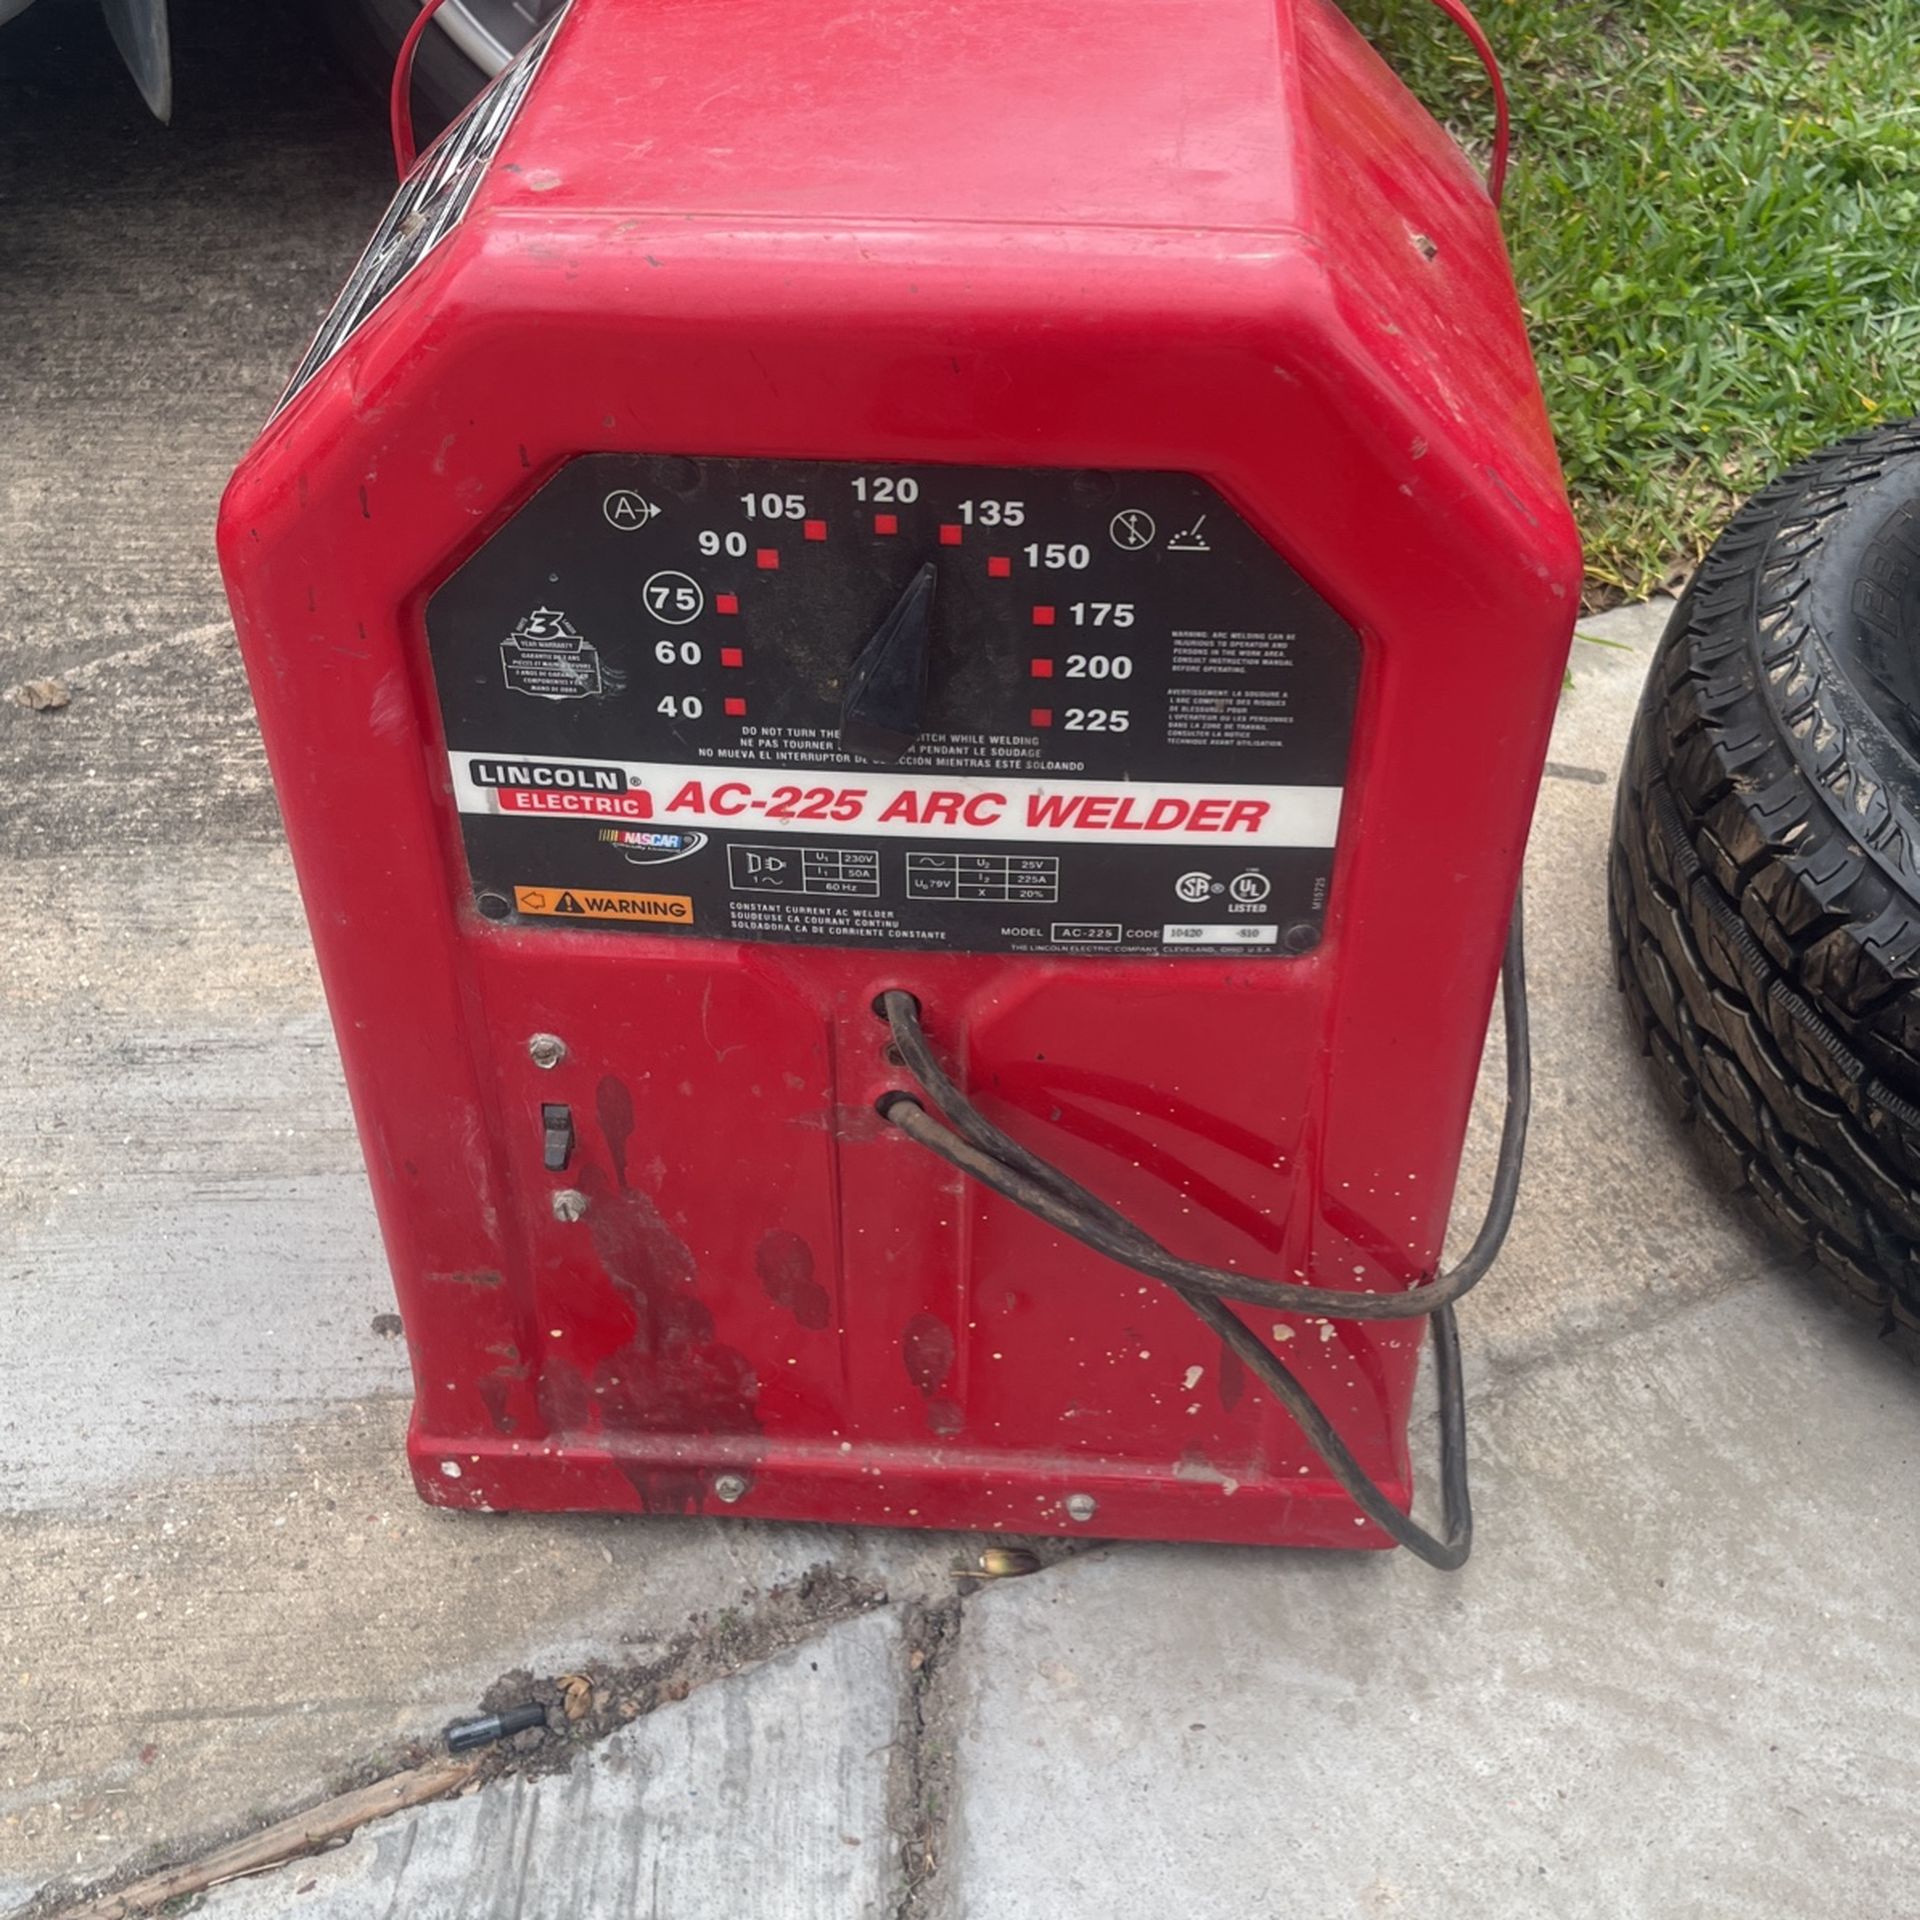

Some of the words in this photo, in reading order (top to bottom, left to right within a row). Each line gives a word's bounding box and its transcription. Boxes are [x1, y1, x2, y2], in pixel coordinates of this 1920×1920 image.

[852, 478, 918, 503] 120
[741, 493, 806, 521] 105
[958, 501, 1025, 526] 135
[699, 532, 747, 557] 90
[1023, 544, 1091, 569] 150
[649, 587, 696, 611] 75
[525, 611, 564, 640] 3
[1069, 603, 1135, 628] 175
[655, 642, 701, 665] 60
[1065, 656, 1133, 680] 200
[657, 696, 702, 720] 40
[1064, 709, 1130, 732] 225
[742, 726, 757, 736] DO
[761, 726, 782, 737] NOT
[787, 727, 816, 738] TURN
[820, 728, 841, 739] THE
[951, 733, 984, 745] WHILE
[989, 734, 1040, 746] WELDING
[740, 738, 753, 748] NE
[758, 739, 780, 749] PAS
[783, 740, 834, 750] TOURNER
[920, 745, 969, 756] PENDANT
[974, 747, 986, 757] LE
[991, 747, 1041, 759] SOUDAGE
[699, 748, 714, 758] NO
[718, 749, 755, 759] MUEVA
[759, 751, 772, 760] EL
[776, 752, 851, 763] INTERRUPTOR
[936, 757, 991, 768] MIENTRAS
[995, 759, 1022, 769] ESTE
[1026, 760, 1085, 771] SOLDANDO
[478, 765, 618, 790] LINCOLN
[516, 792, 639, 815] ELECTRIC
[665, 781, 867, 821] AC-225
[878, 790, 1006, 827] ARC
[1026, 795, 1271, 833] WELDER
[624, 832, 680, 848] NASCAR
[844, 854, 874, 863] 230V
[1021, 861, 1044, 869] 25V
[848, 869, 871, 878] 50A
[1017, 875, 1047, 884] 225A
[826, 883, 840, 892] 60
[842, 884, 858, 892] Hz
[978, 888, 986, 897] X
[1020, 890, 1044, 898] 20%
[1239, 879, 1260, 897] UL
[585, 897, 687, 917] WARNING
[730, 902, 781, 913] CONSTANT
[785, 906, 832, 916] CURRENT
[836, 909, 849, 917] AC
[853, 910, 895, 919] WELDER
[1228, 904, 1267, 913] LISTED
[731, 912, 782, 922] SOUDEUSE
[787, 915, 801, 923] CA
[804, 917, 851, 926] COURANT
[855, 919, 900, 929] CONTINU
[795, 925, 808, 933] CA
[812, 926, 824, 934] DE
[829, 928, 884, 937] CORRIENTE
[888, 930, 947, 940] CONSTANTE
[1001, 927, 1044, 937] MODEL
[1062, 929, 1113, 938] AC-225
[1126, 929, 1161, 939] CODE
[1170, 928, 1203, 938] 10420
[1011, 944, 1028, 952] THE
[1030, 944, 1069, 952] LINCOLN
[1070, 945, 1113, 953] ELECTRIC
